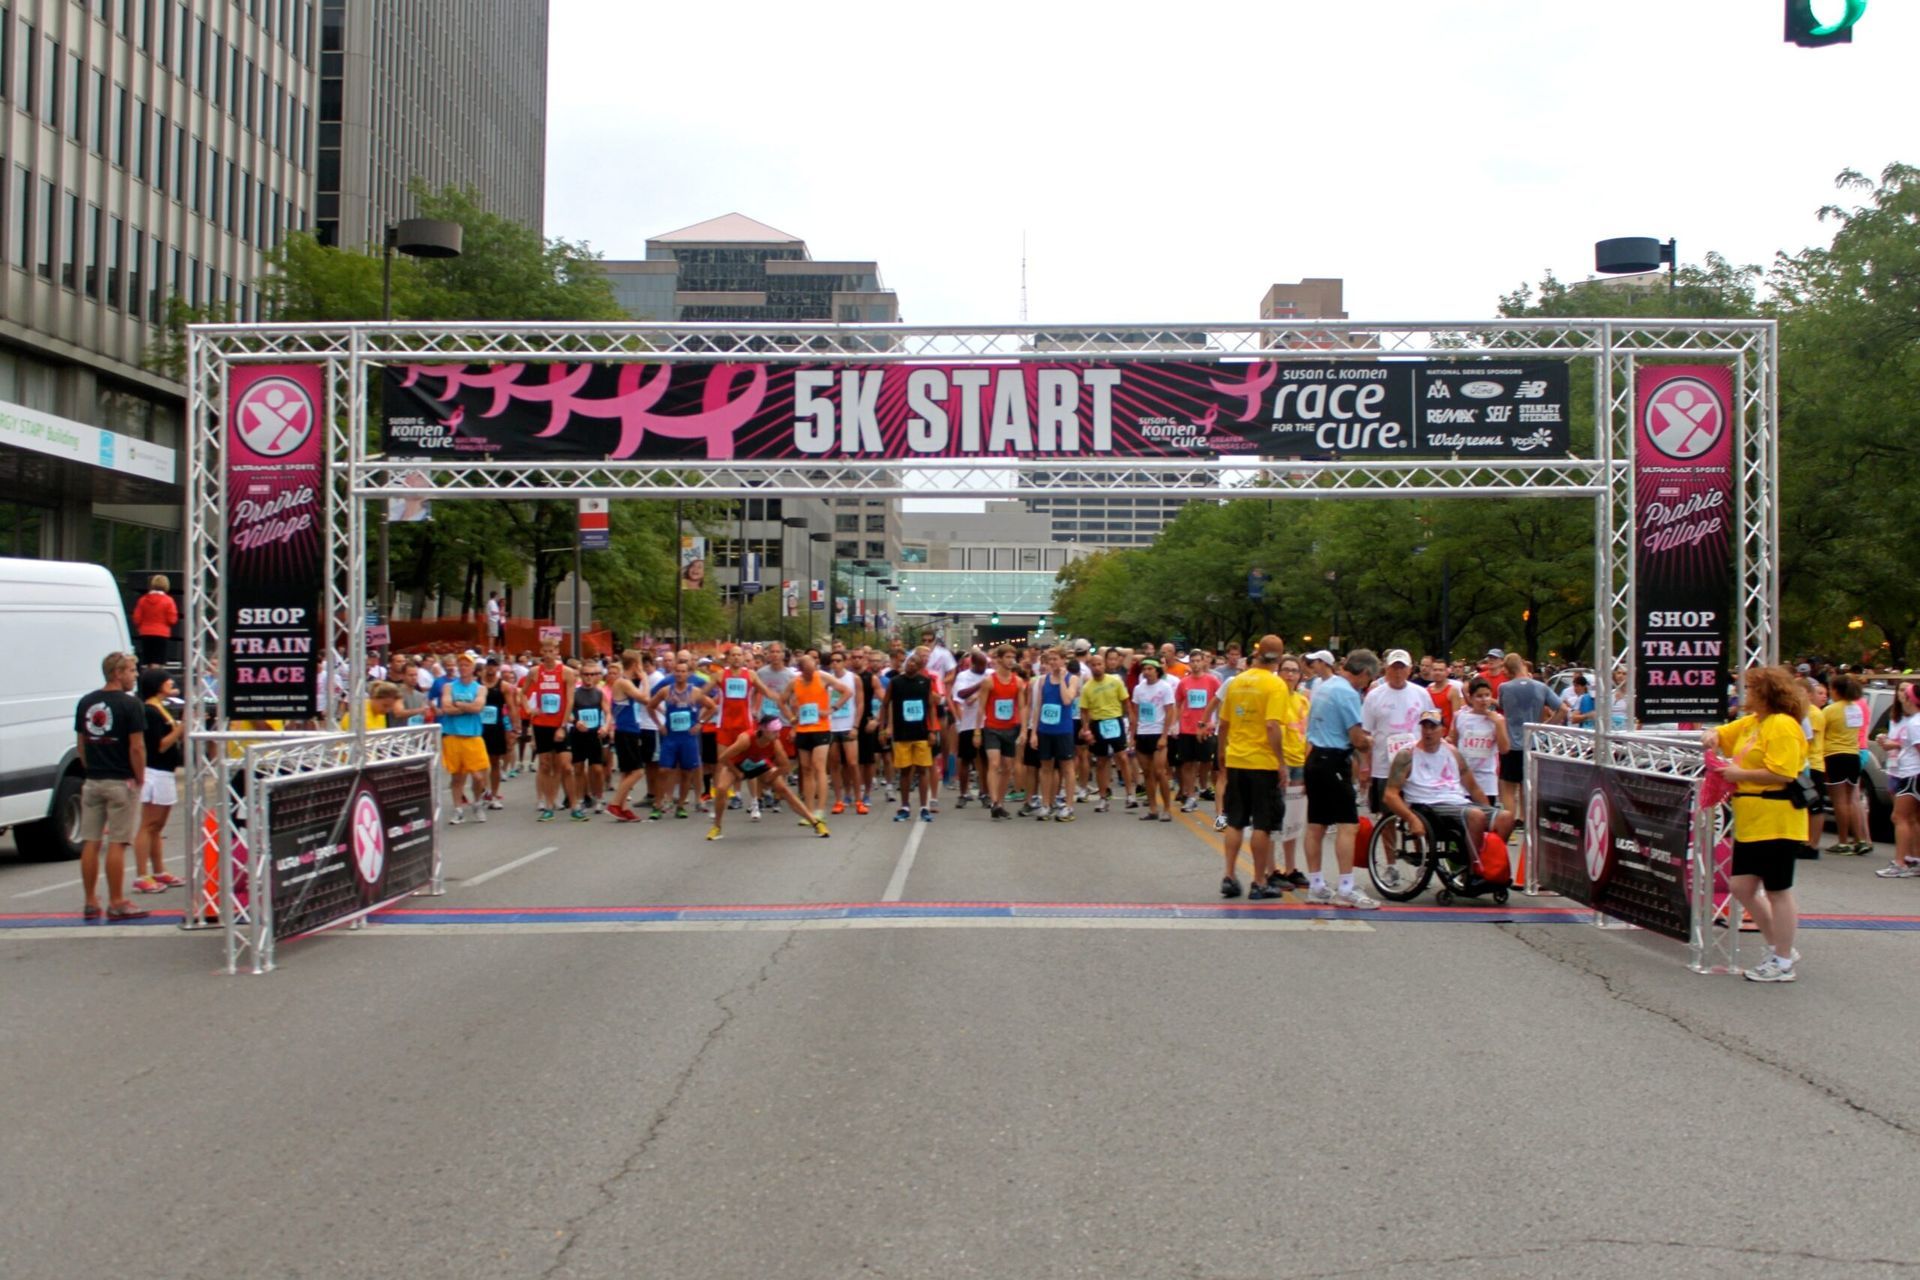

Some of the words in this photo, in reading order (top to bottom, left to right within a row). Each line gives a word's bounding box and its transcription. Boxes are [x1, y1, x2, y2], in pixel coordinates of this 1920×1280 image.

[1326, 369, 1337, 379] G.
[1273, 384, 1385, 419] race
[1519, 404, 1561, 413] STANLEY
[794, 370, 884, 453] 5K
[907, 369, 1121, 452] START
[1485, 405, 1513, 422] SELF
[1271, 423, 1293, 432] FOR
[1295, 423, 1316, 432] THE
[1426, 433, 1504, 450] Walgreens
[233, 484, 313, 527] Prairie
[1643, 487, 1724, 528] Prairie
[233, 513, 311, 551] Village
[1644, 517, 1722, 554] Village
[237, 608, 305, 624] SHOP
[1648, 611, 1716, 627] SHOP
[231, 637, 312, 654] TRAIN
[1642, 640, 1722, 656] TRAIN
[237, 667, 305, 683] RACE
[1648, 670, 1716, 686] RACE
